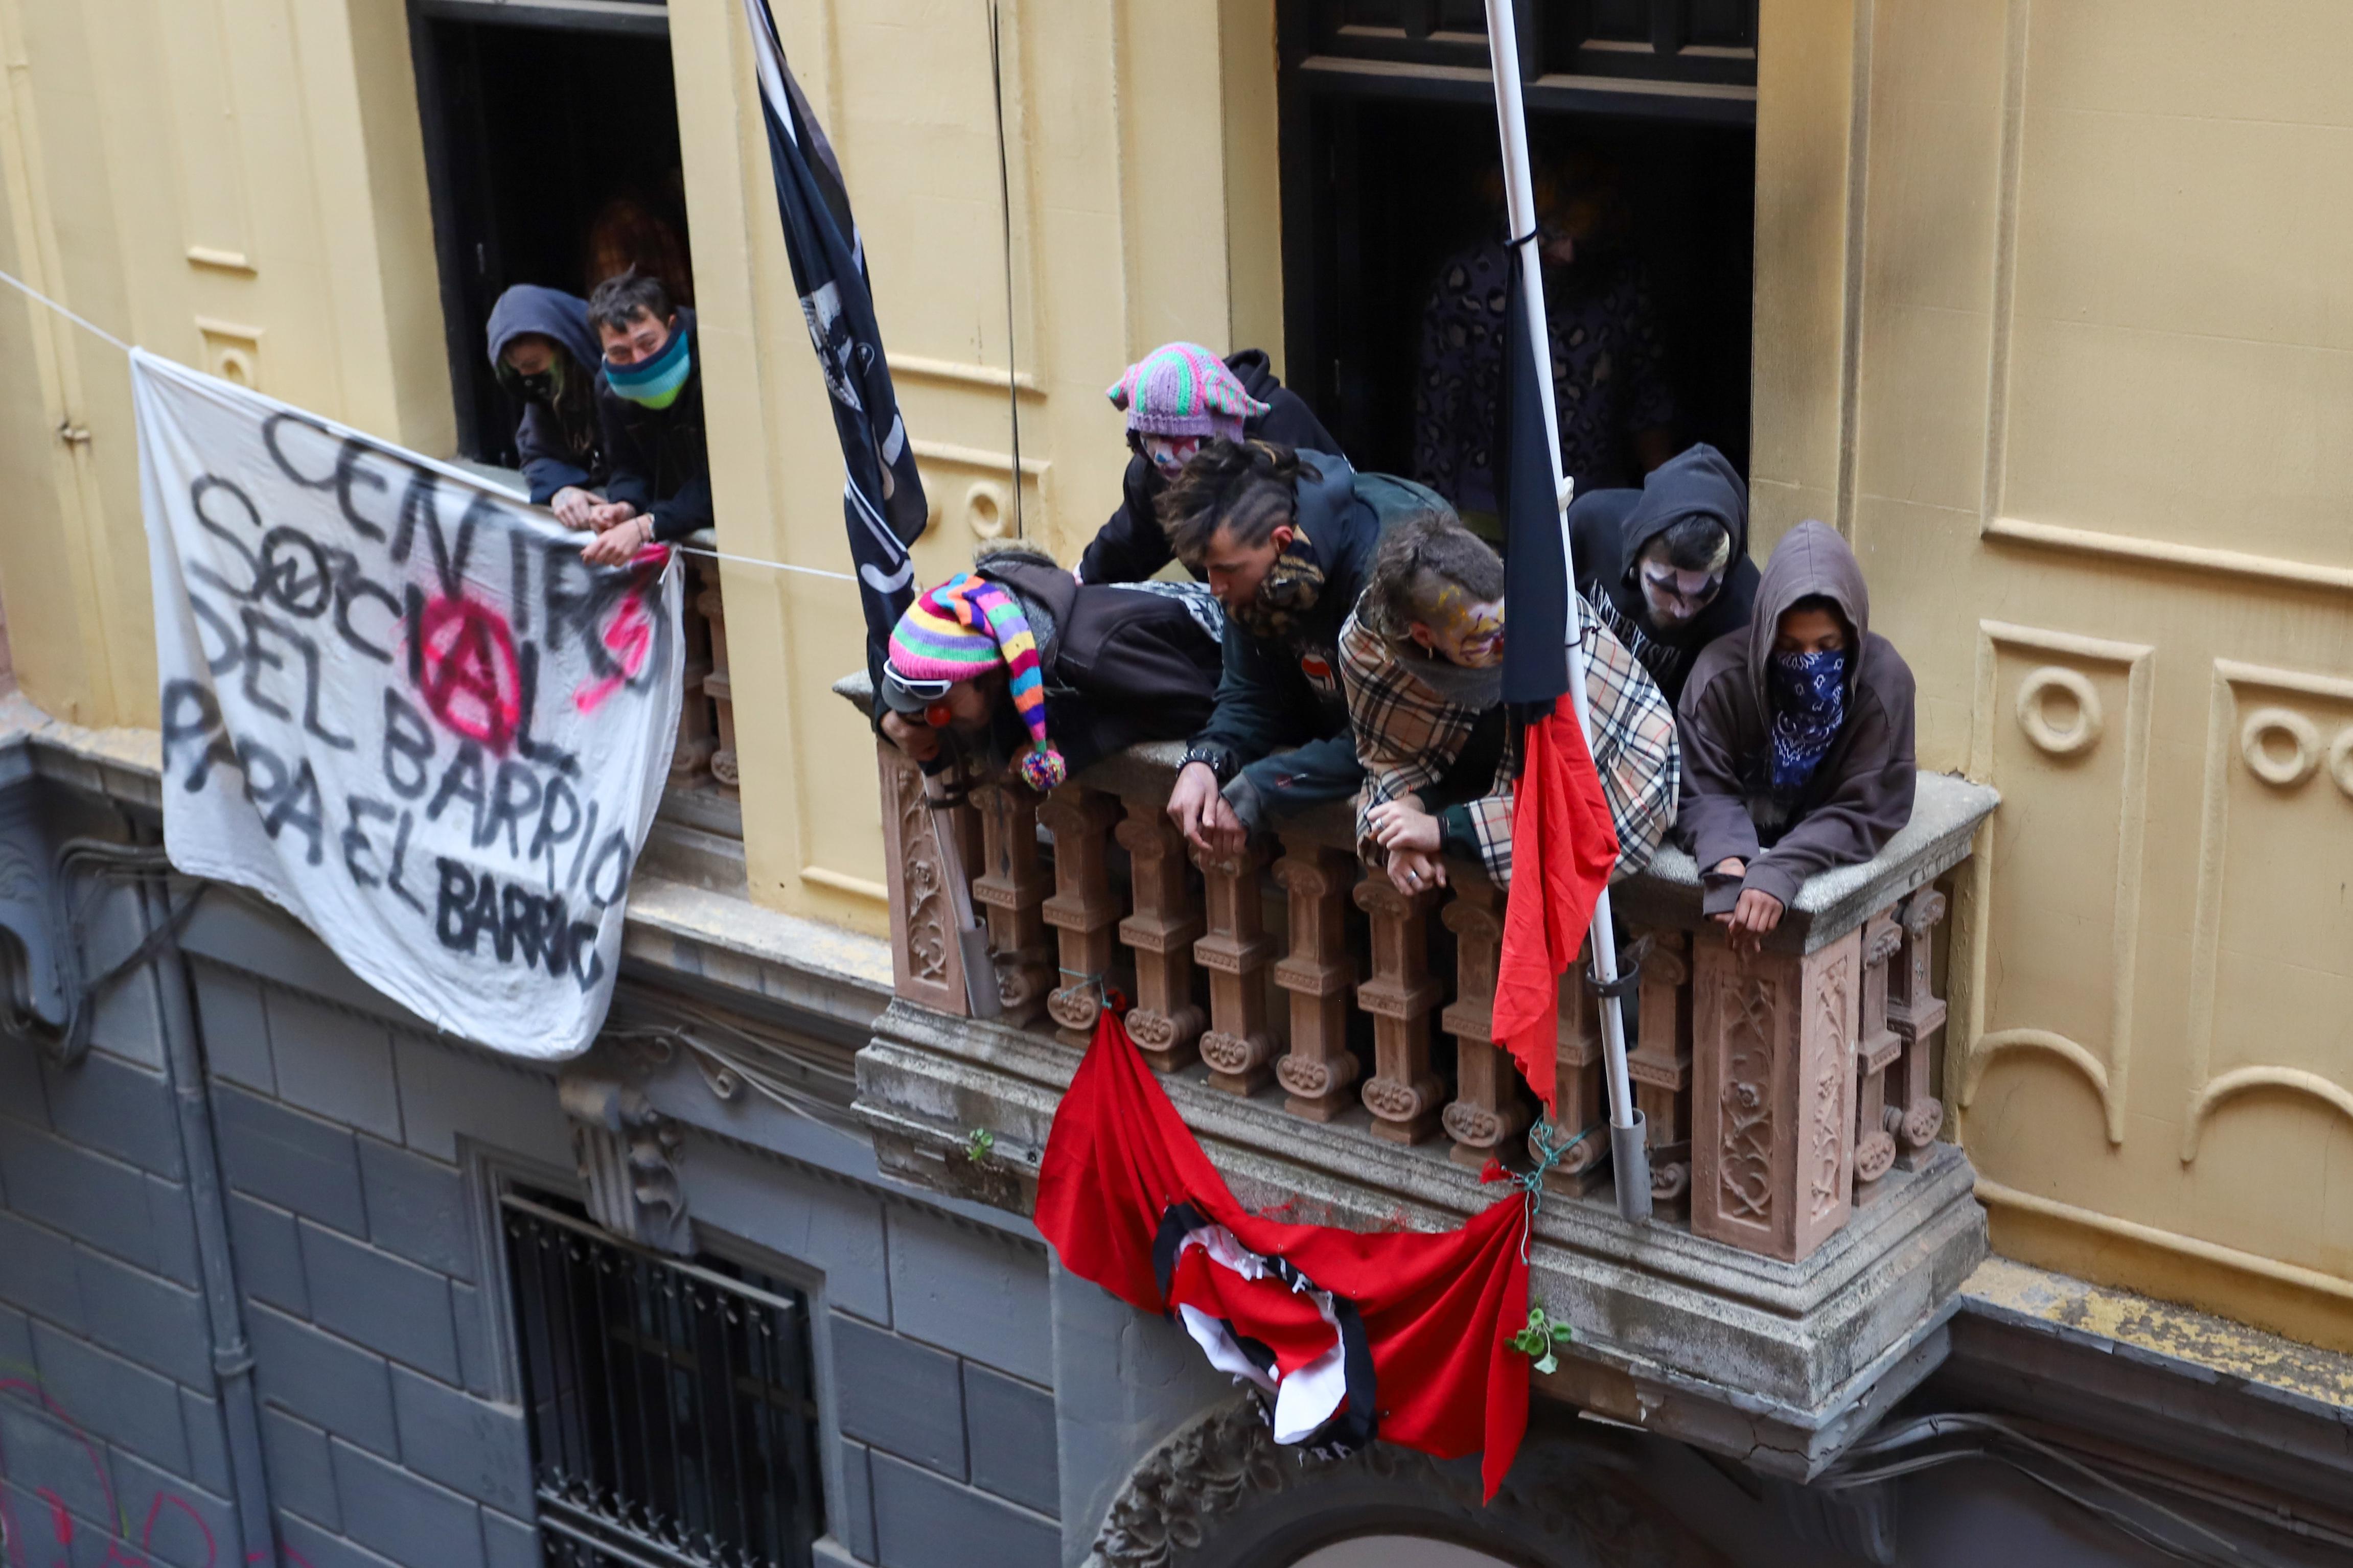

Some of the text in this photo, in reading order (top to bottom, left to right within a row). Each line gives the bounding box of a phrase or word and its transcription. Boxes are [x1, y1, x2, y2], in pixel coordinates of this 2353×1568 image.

[262, 412, 671, 694] CENTRO
[188, 591, 632, 910] DEL BARRIO
[341, 794, 427, 916] EL
